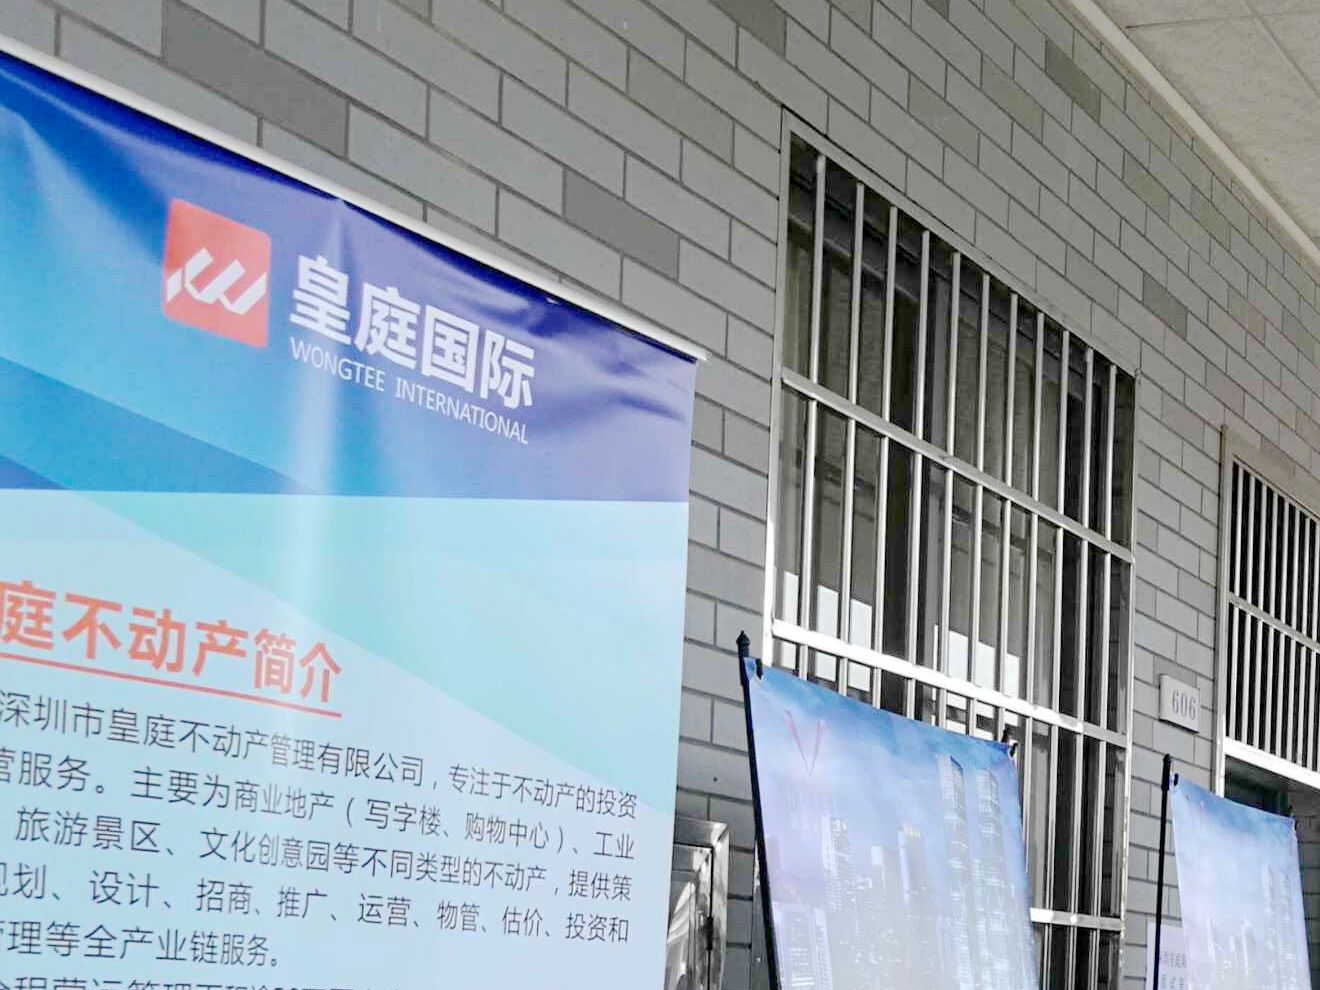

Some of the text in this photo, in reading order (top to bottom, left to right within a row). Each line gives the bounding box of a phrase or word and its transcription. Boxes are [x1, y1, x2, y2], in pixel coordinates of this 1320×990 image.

[289, 254, 536, 409] 皇庭国际
[290, 336, 529, 445] WONGTEE INTERNATIONAL
[0, 580, 342, 704] 庭不动产简介
[1171, 689, 1197, 721] 606
[0, 862, 630, 943] 划、设计、招商、推广、运营、物管、估价、投资和
[0, 920, 278, 968] 理等全产业链服务。
